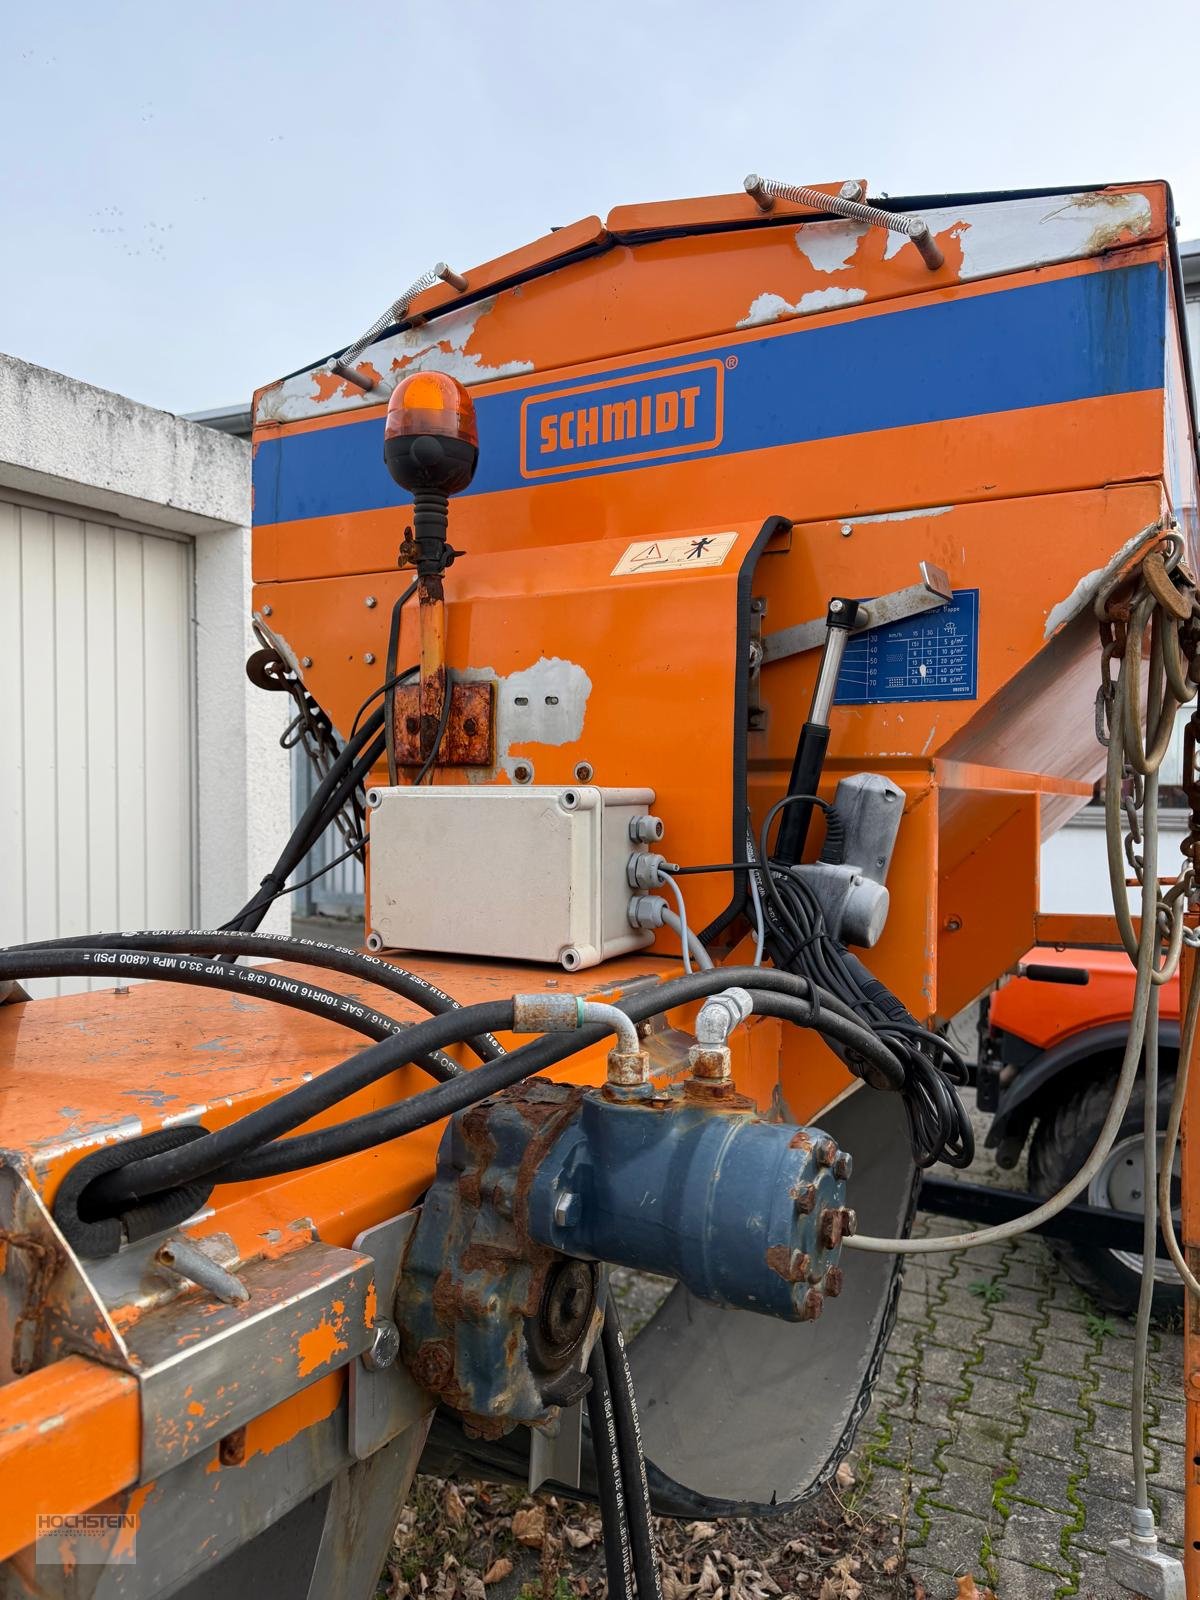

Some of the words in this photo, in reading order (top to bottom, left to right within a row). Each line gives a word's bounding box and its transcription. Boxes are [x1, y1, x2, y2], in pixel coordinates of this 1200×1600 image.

[540, 386, 700, 454] SCHMIDT
[869, 679, 877, 687] 70
[152, 929, 186, 937] GATES
[300, 938, 315, 947] EN
[362, 953, 381, 965] ISO
[93, 952, 117, 964] PSI)
[119, 953, 150, 966] (4800
[152, 955, 178, 969] MPa
[179, 960, 204, 972] 33.0
[205, 965, 225, 976] WP
[268, 978, 299, 994] DN10
[300, 987, 339, 1008] 100R16
[340, 1001, 365, 1018] SAE
[370, 1014, 392, 1031] R16
[440, 1057, 458, 1072] ISO
[623, 1361, 635, 1398] GATES
[603, 1398, 613, 1419] PSI)
[606, 1419, 616, 1447] (4800
[611, 1447, 620, 1470] MPa
[616, 1492, 624, 1510] WP
[621, 1546, 631, 1574] DN10
